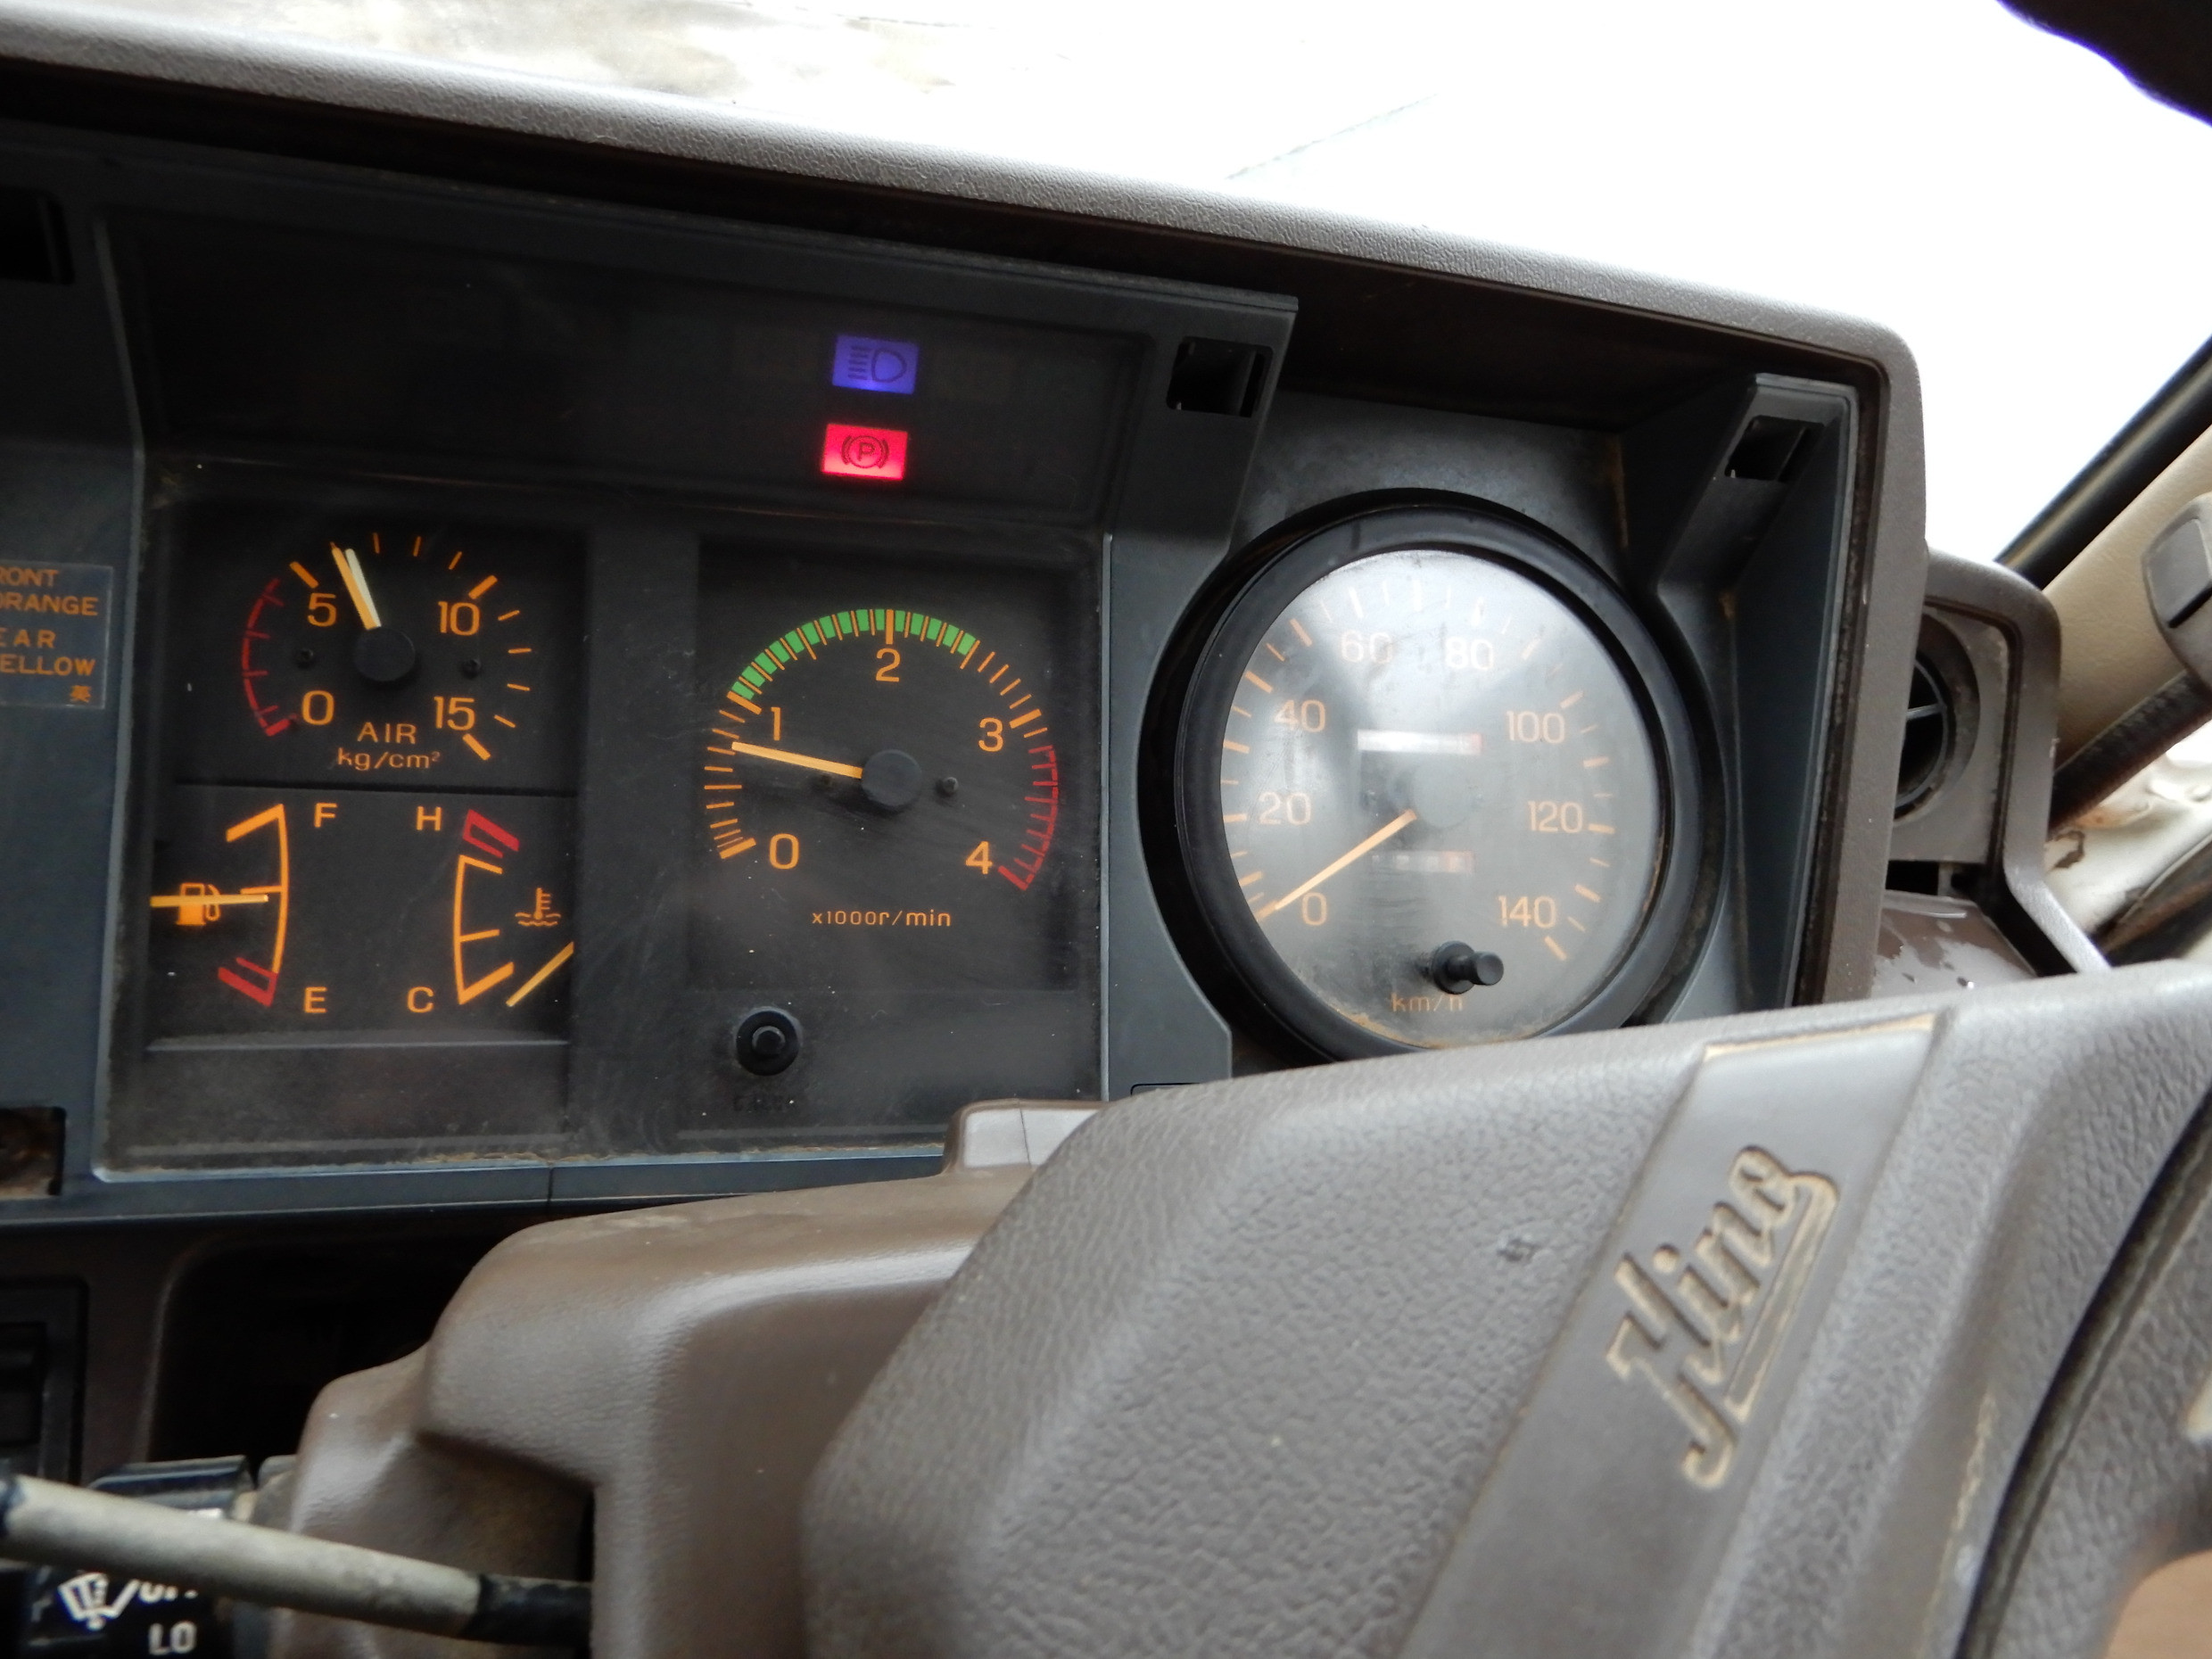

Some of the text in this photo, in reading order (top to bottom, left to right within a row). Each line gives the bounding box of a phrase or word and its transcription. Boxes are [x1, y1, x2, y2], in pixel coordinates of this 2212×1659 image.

[0, 591, 98, 615] RANGE
[308, 593, 337, 626] 5
[438, 601, 480, 635] 10
[1339, 631, 1393, 664] 60
[1444, 637, 1494, 671] 80
[876, 648, 900, 681] 2
[302, 690, 334, 726] 0
[434, 696, 475, 731] 15
[771, 706, 781, 740] 1
[1275, 699, 1326, 733] 40
[358, 722, 417, 744] AIR
[978, 718, 1003, 752] 3
[1506, 711, 1564, 744] 100
[314, 804, 338, 828] F
[417, 806, 442, 831] H
[1259, 792, 1312, 825] 20
[1528, 801, 1583, 834] 120
[770, 833, 799, 869] 0
[966, 841, 993, 875] 4
[1301, 892, 1327, 926] 0
[1498, 896, 1556, 929] 140
[304, 988, 326, 1013] E
[407, 986, 434, 1014] C
